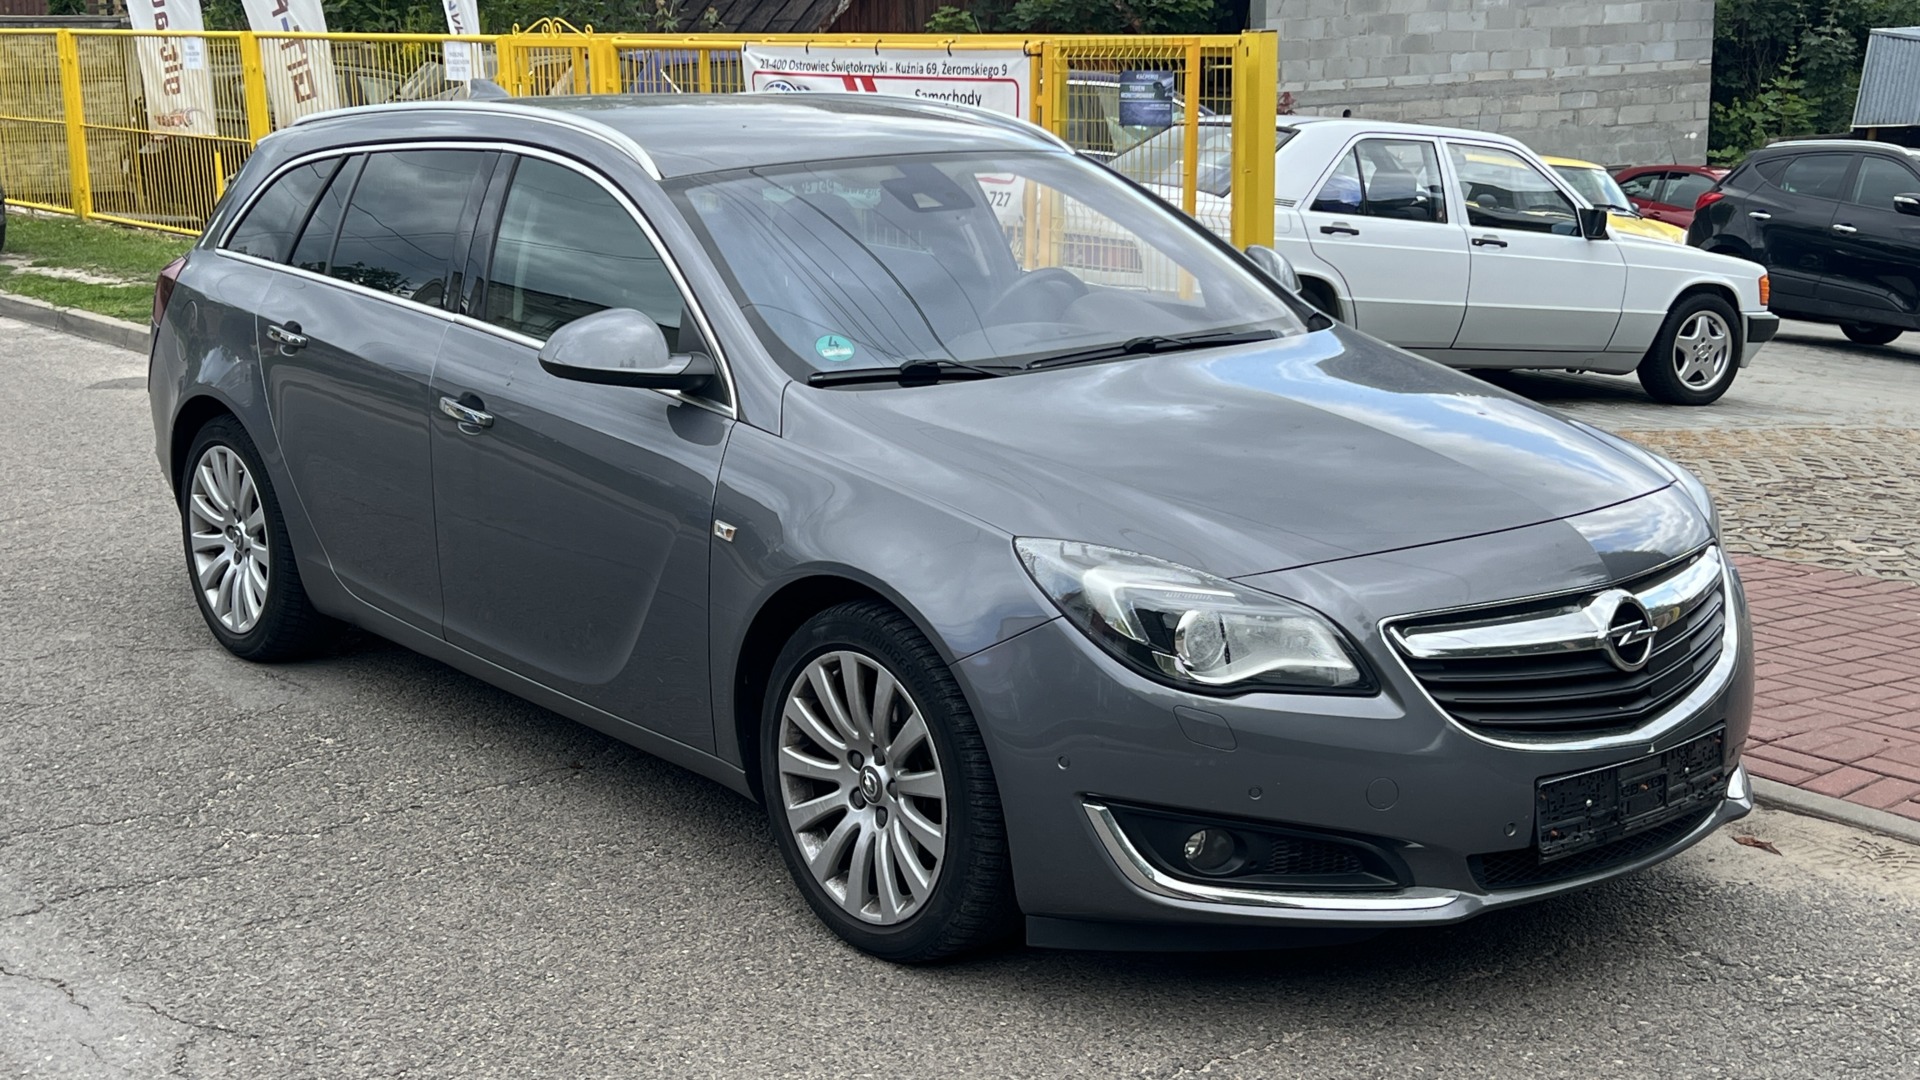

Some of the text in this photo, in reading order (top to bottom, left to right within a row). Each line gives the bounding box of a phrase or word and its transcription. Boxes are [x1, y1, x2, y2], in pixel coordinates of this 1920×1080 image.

[789, 60, 830, 72] Ostrowiec
[832, 59, 887, 76] Świętokrzyski
[895, 62, 924, 75] Kuźnia
[926, 63, 939, 77] 69,
[942, 61, 999, 79] Żeromskiego
[1002, 64, 1008, 76] 9
[989, 191, 1011, 207] 727
[828, 336, 839, 348] 4
